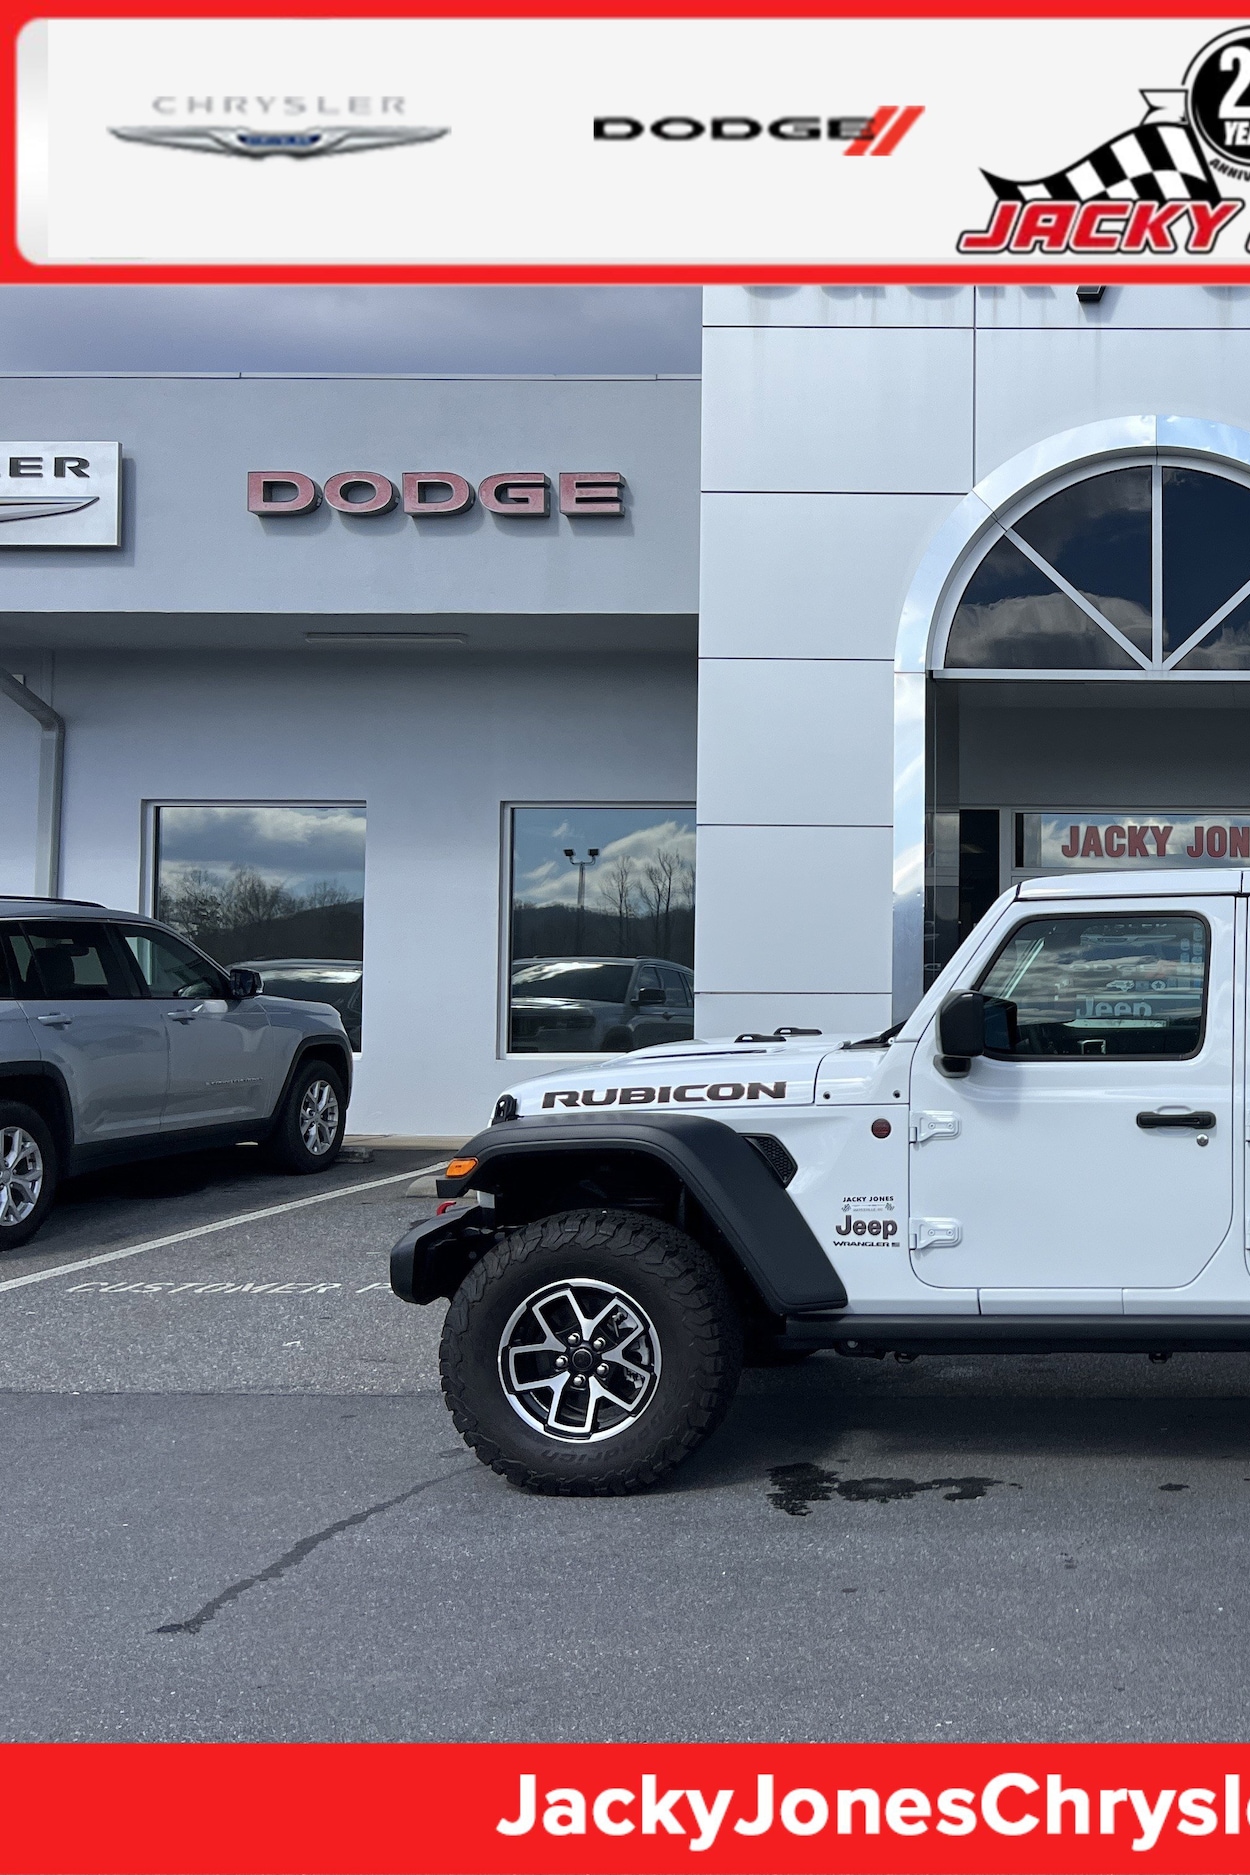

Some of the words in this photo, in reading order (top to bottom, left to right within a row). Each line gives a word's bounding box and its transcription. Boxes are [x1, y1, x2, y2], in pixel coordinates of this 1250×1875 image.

[0, 456, 90, 478] ER
[247, 471, 626, 517] DODGE
[1061, 825, 1174, 858] JACKY
[541, 1081, 787, 1109] RUBICON
[835, 1215, 898, 1240] Jeep
[65, 1282, 342, 1294] CUSTOMER
